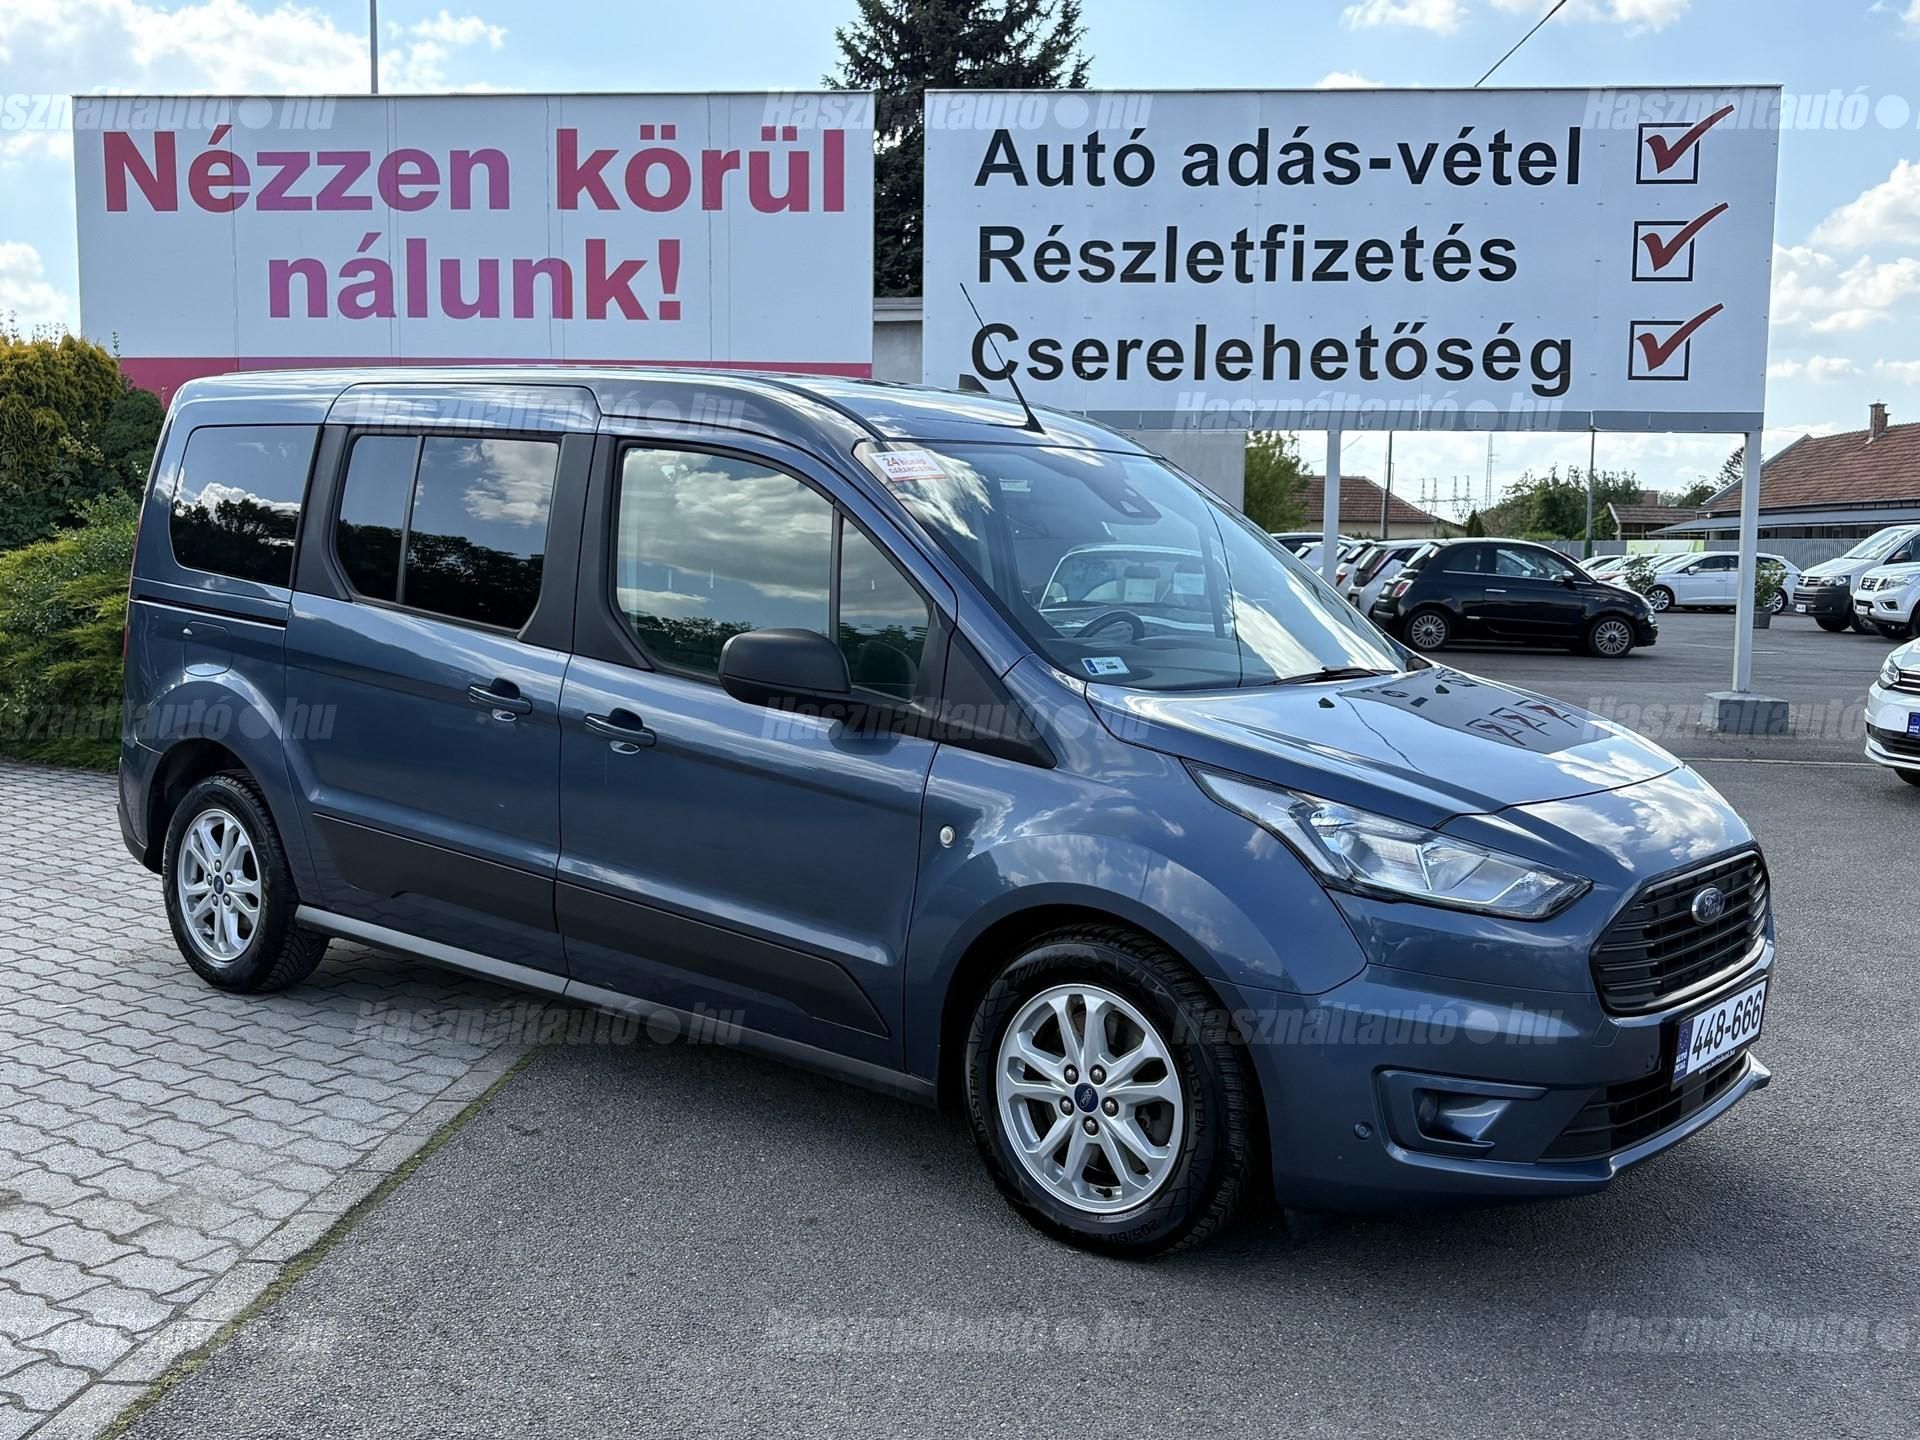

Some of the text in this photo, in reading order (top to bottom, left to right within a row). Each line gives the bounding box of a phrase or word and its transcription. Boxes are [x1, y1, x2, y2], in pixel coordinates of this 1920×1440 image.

[103, 124, 845, 213] Nézzen körül
[974, 125, 1581, 187] Autó adás-vétel
[268, 232, 681, 321] nálunk!
[978, 223, 1517, 284] Részletfizetés
[971, 321, 1572, 397] Cserelehetőség
[1691, 990, 1761, 1061] 448-666
